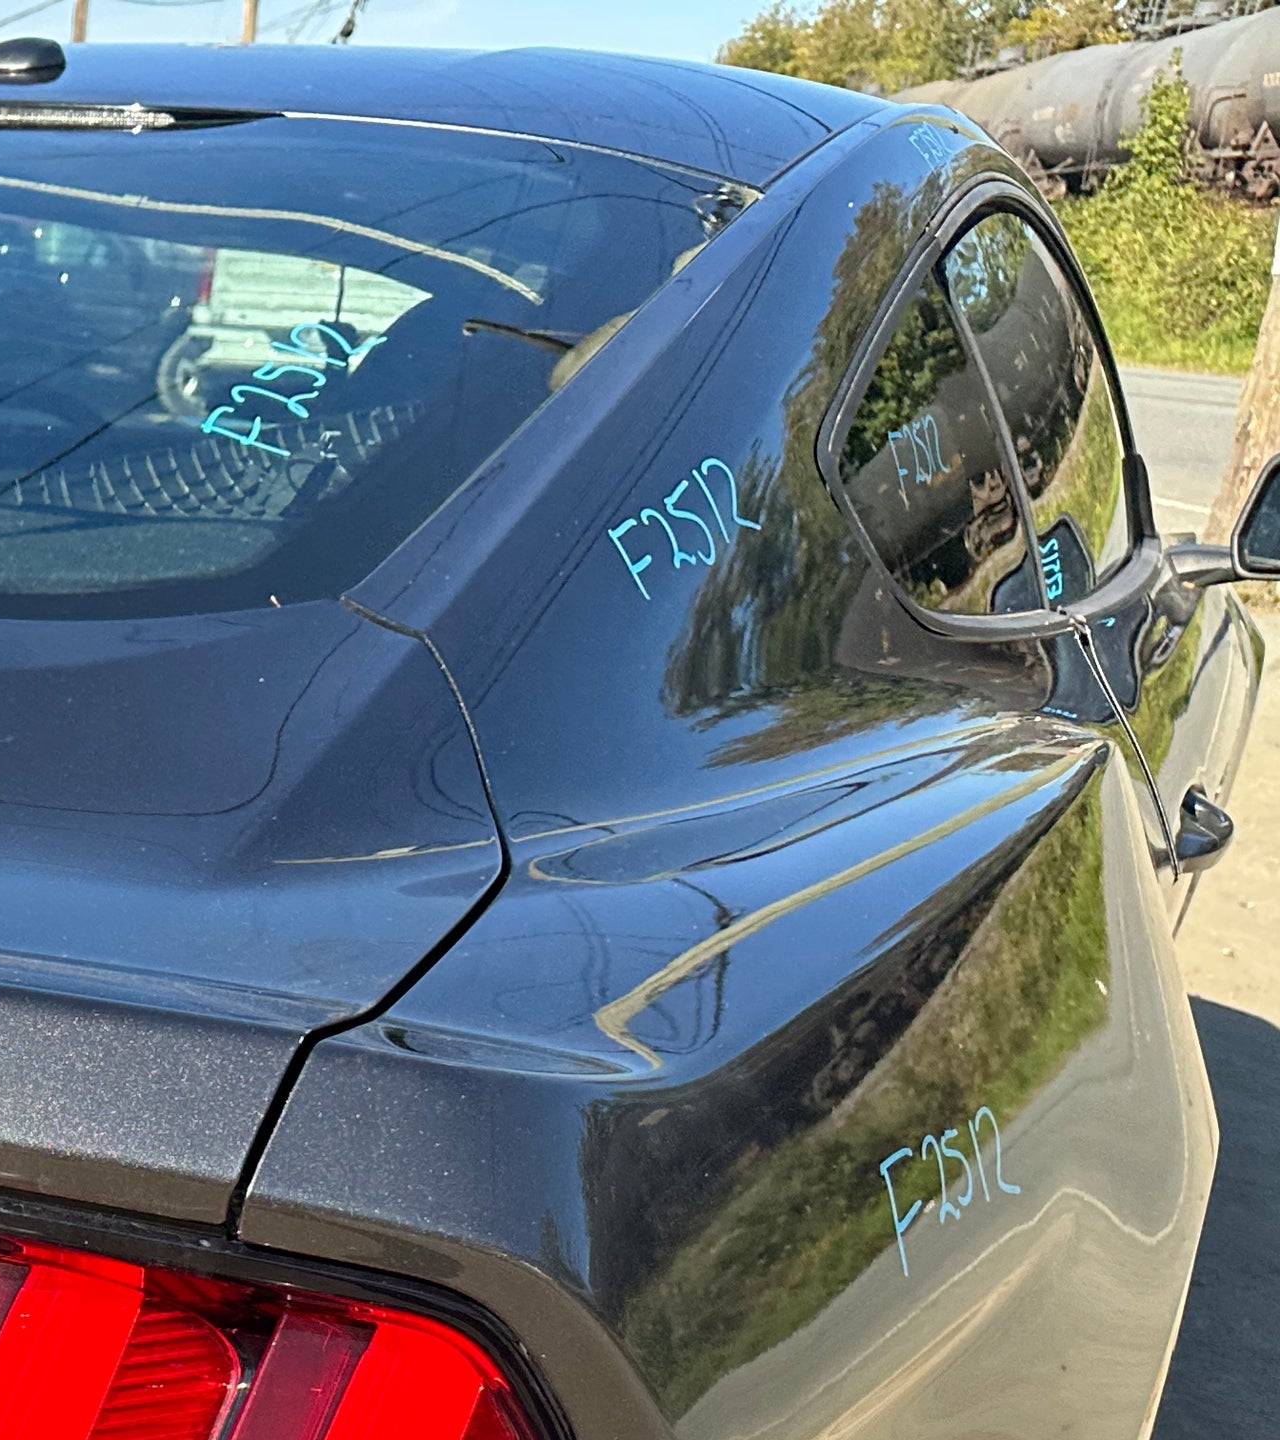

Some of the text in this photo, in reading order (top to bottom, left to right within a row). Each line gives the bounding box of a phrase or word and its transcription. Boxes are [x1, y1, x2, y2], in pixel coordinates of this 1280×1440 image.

[200, 322, 389, 457] F2512
[608, 457, 762, 600] F2512
[887, 413, 951, 511] F2512
[879, 1105, 1022, 1277] F2512
